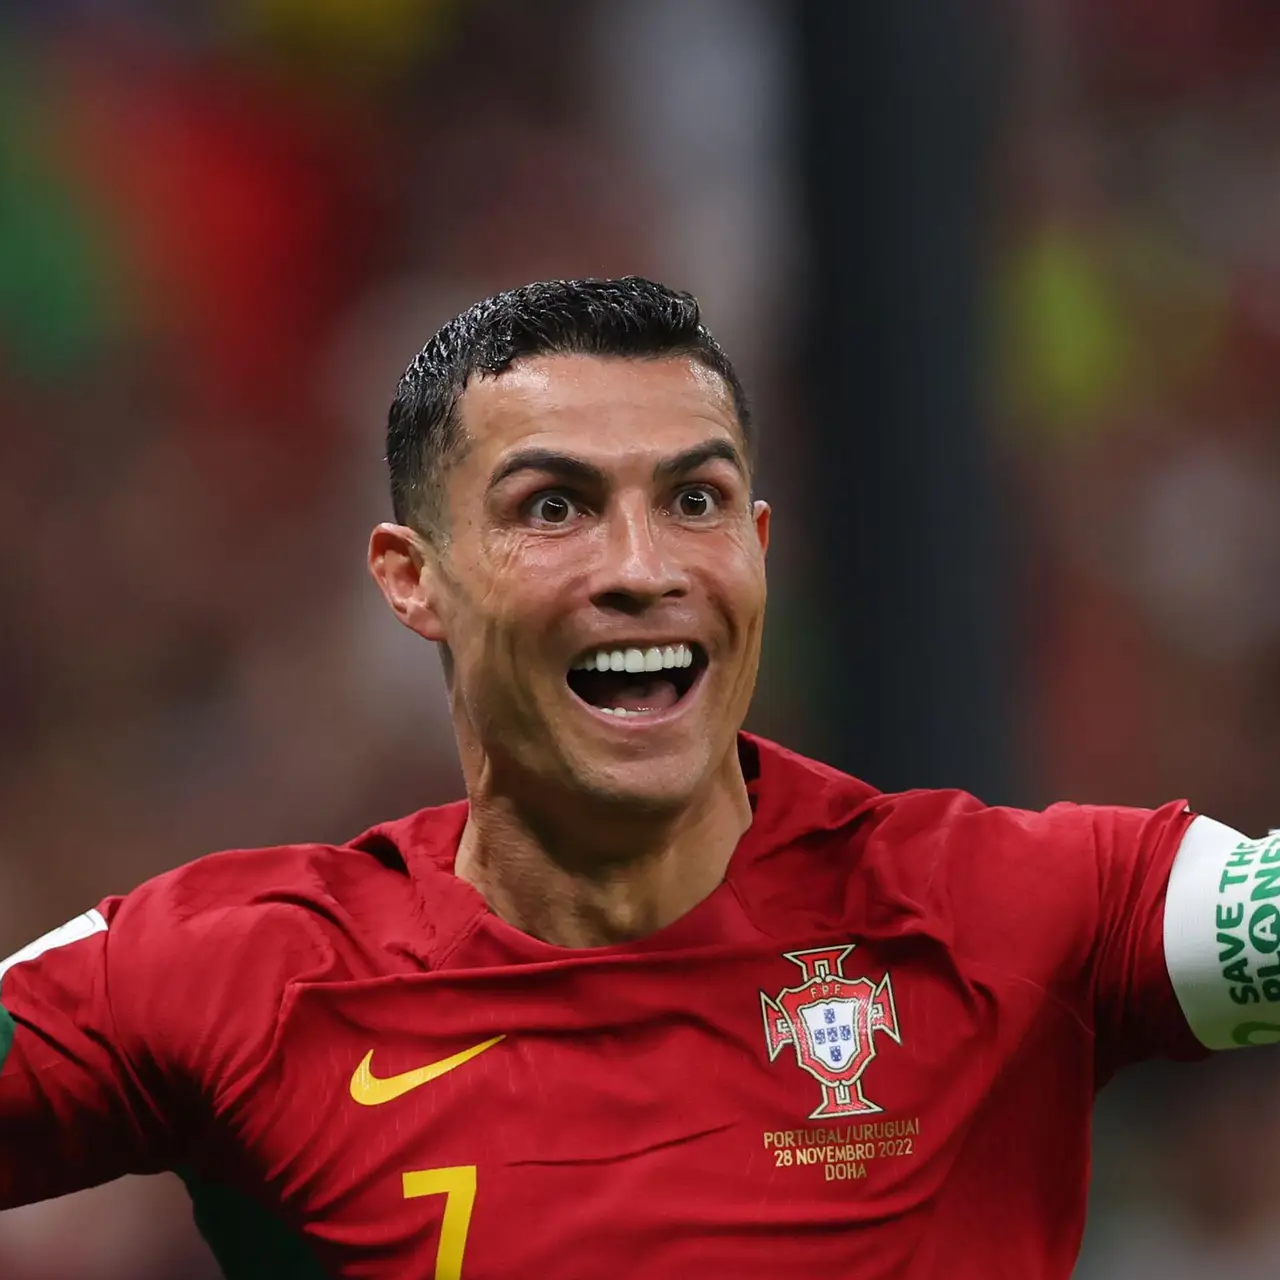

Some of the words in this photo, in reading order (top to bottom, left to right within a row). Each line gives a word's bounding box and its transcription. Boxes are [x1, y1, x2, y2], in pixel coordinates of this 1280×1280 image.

[1219, 841, 1266, 893] THE
[1216, 902, 1260, 1005] SAVE
[763, 1118, 920, 1149] PORTUGAL/URUGUAI
[774, 1149, 793, 1167] 28
[796, 1143, 875, 1166] NOVEMBRO
[878, 1138, 913, 1158] 2022
[825, 1162, 867, 1181] DOHA
